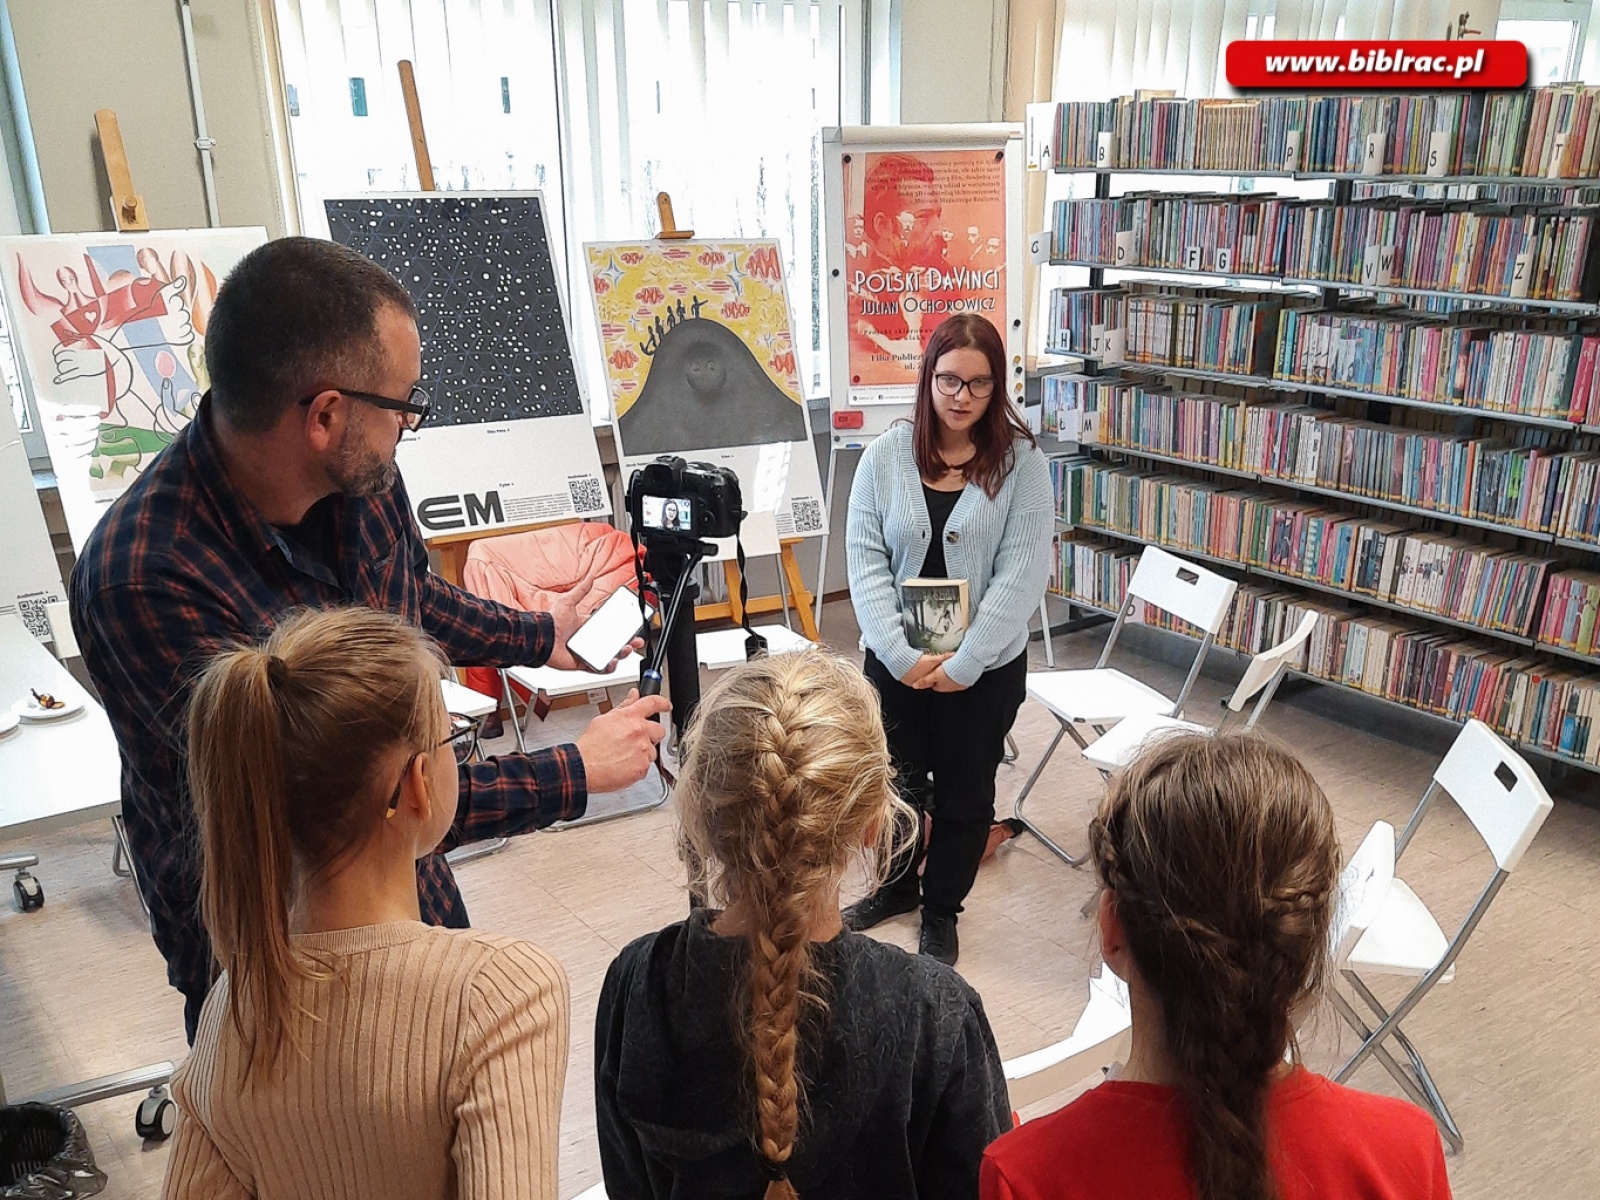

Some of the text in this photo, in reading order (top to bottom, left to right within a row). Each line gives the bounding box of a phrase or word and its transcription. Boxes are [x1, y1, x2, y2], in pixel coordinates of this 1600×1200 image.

[1043, 145, 1050, 158] A
[1099, 146, 1105, 161] B
[1286, 146, 1294, 162] P
[1368, 142, 1375, 159] R
[1429, 150, 1437, 167] S
[1555, 143, 1563, 160] T
[1117, 246, 1125, 260] D
[1189, 251, 1197, 268] F
[1218, 252, 1226, 269] G
[1381, 254, 1393, 271] W
[1365, 263, 1373, 279] V
[1514, 262, 1525, 280] Z
[861, 297, 996, 315] JULIAN OCHOROWICZ
[1061, 332, 1067, 348] H
[1092, 338, 1101, 351] J
[1105, 338, 1111, 351] K
[1084, 419, 1092, 432] M
